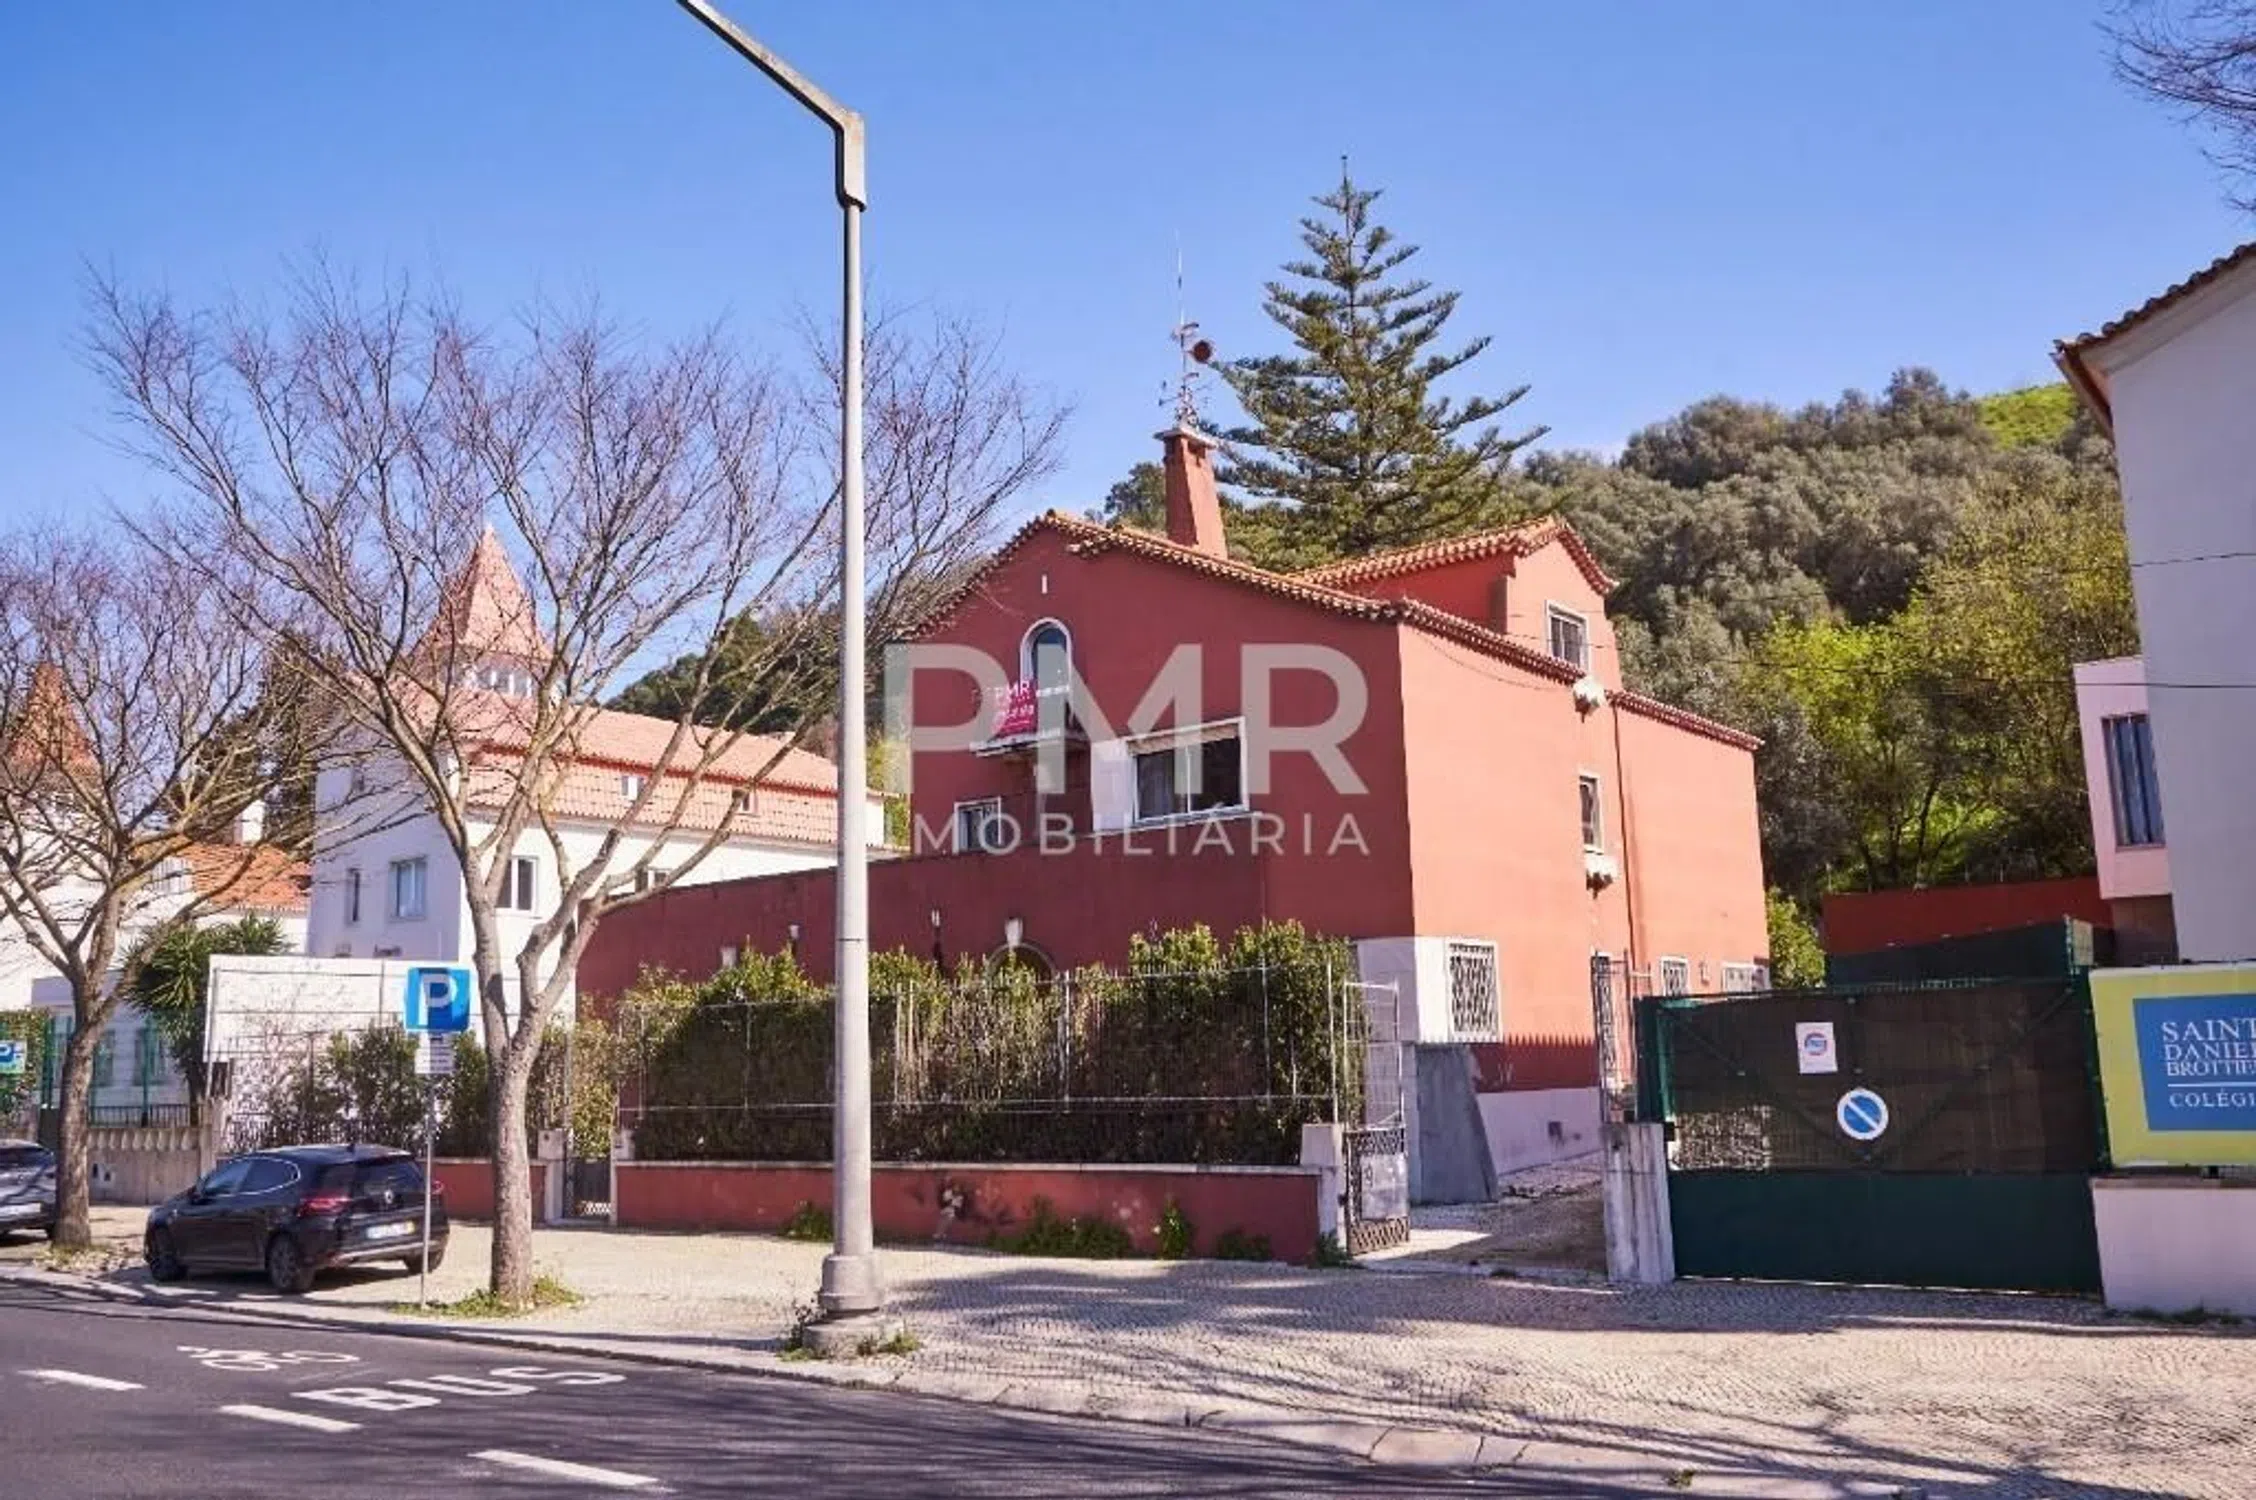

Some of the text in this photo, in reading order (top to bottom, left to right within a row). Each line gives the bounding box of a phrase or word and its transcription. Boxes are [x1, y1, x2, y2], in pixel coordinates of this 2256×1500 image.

[418, 973, 458, 1026] P
[2161, 1017, 2256, 1043] SAINT
[290, 1366, 627, 1411] BUS
